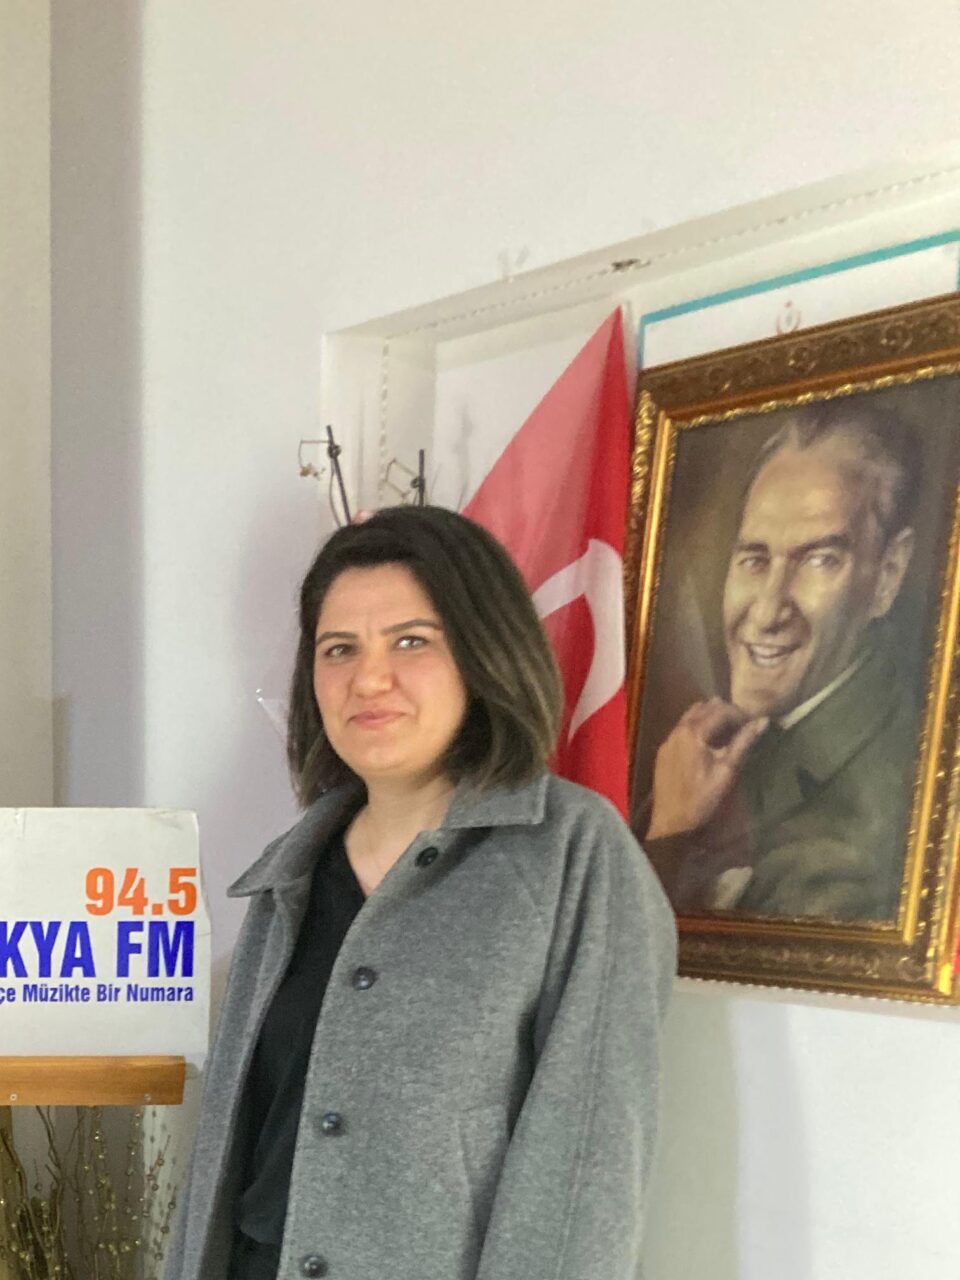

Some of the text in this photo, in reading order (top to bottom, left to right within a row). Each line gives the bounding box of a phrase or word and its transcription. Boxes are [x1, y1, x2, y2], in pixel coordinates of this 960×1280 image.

[85, 867, 197, 916] 94.5
[116, 920, 195, 978] FM
[23, 984, 90, 1002] Müzikte
[97, 985, 121, 1002] Bir
[127, 985, 193, 1002] Numara
